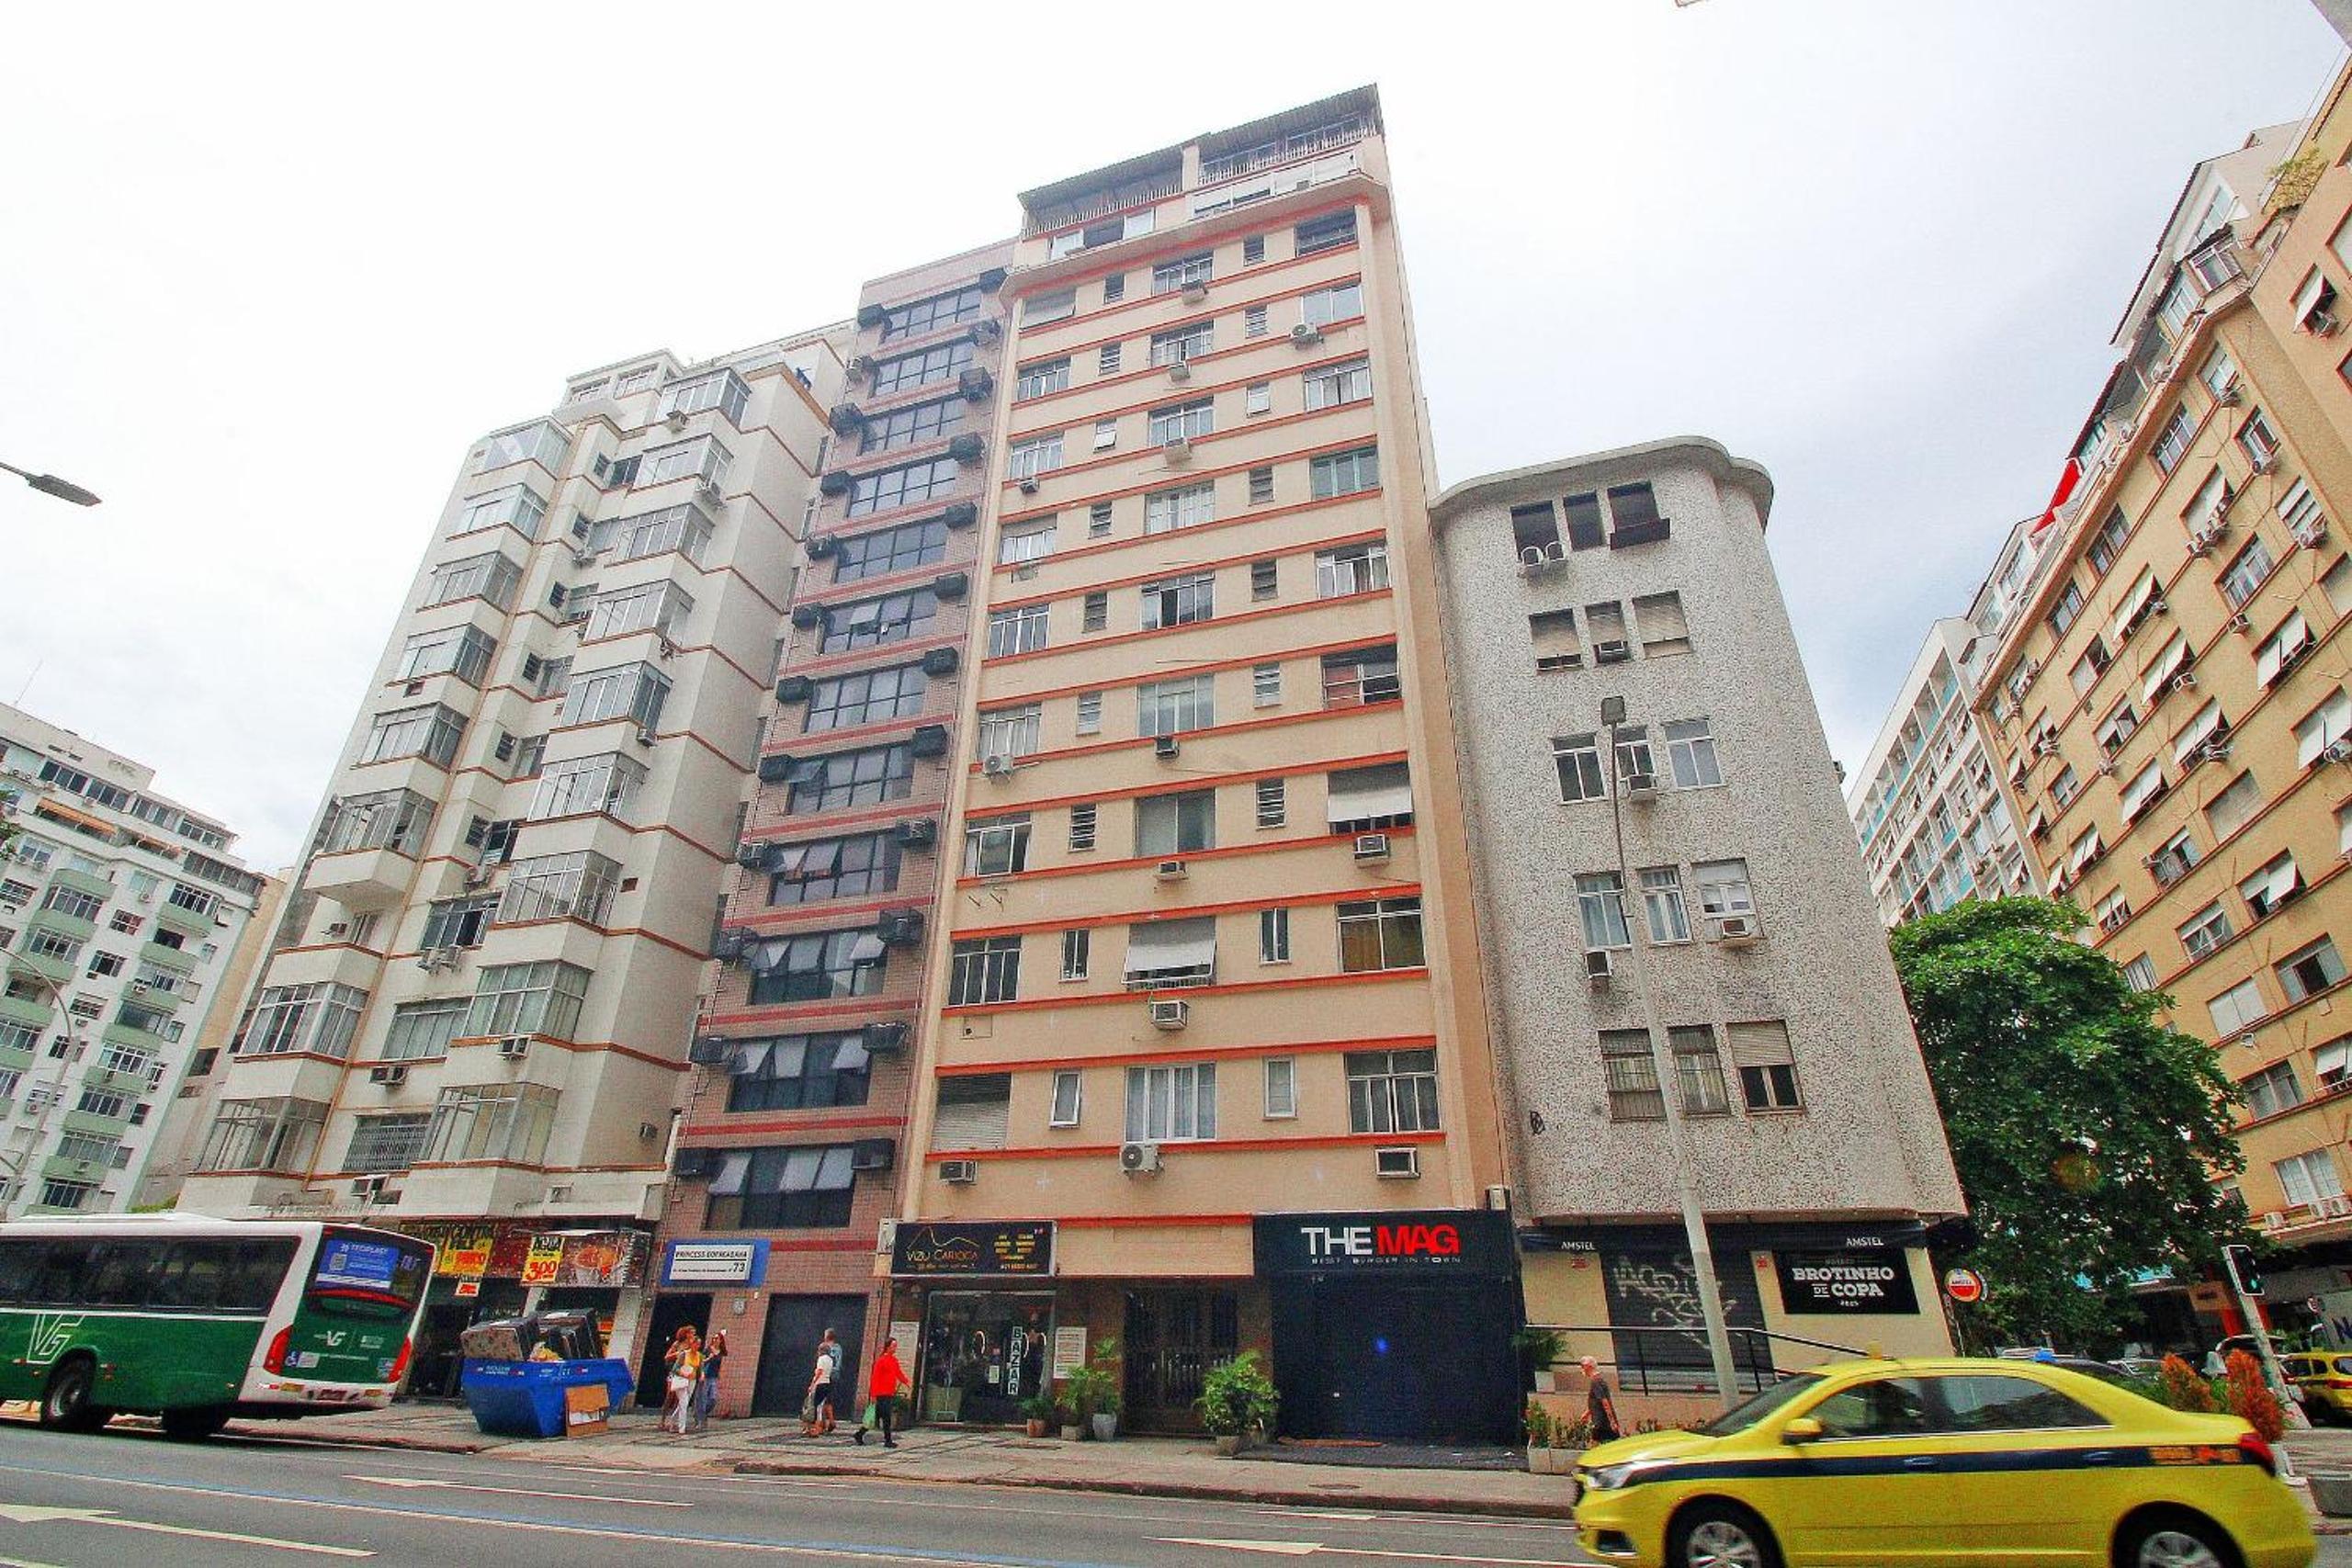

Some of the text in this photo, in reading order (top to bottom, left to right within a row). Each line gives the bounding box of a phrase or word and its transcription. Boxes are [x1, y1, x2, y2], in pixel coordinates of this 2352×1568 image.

[1301, 1224, 1461, 1256] THE MAG
[1562, 1242, 1596, 1250] AMSTEL
[1847, 1237, 1884, 1247] AMSTEL
[733, 1263, 745, 1272] 73
[1792, 1267, 1894, 1280] BROTINHO
[1831, 1282, 1884, 1297] COPA
[1009, 1327, 1022, 1393] BAZAR
